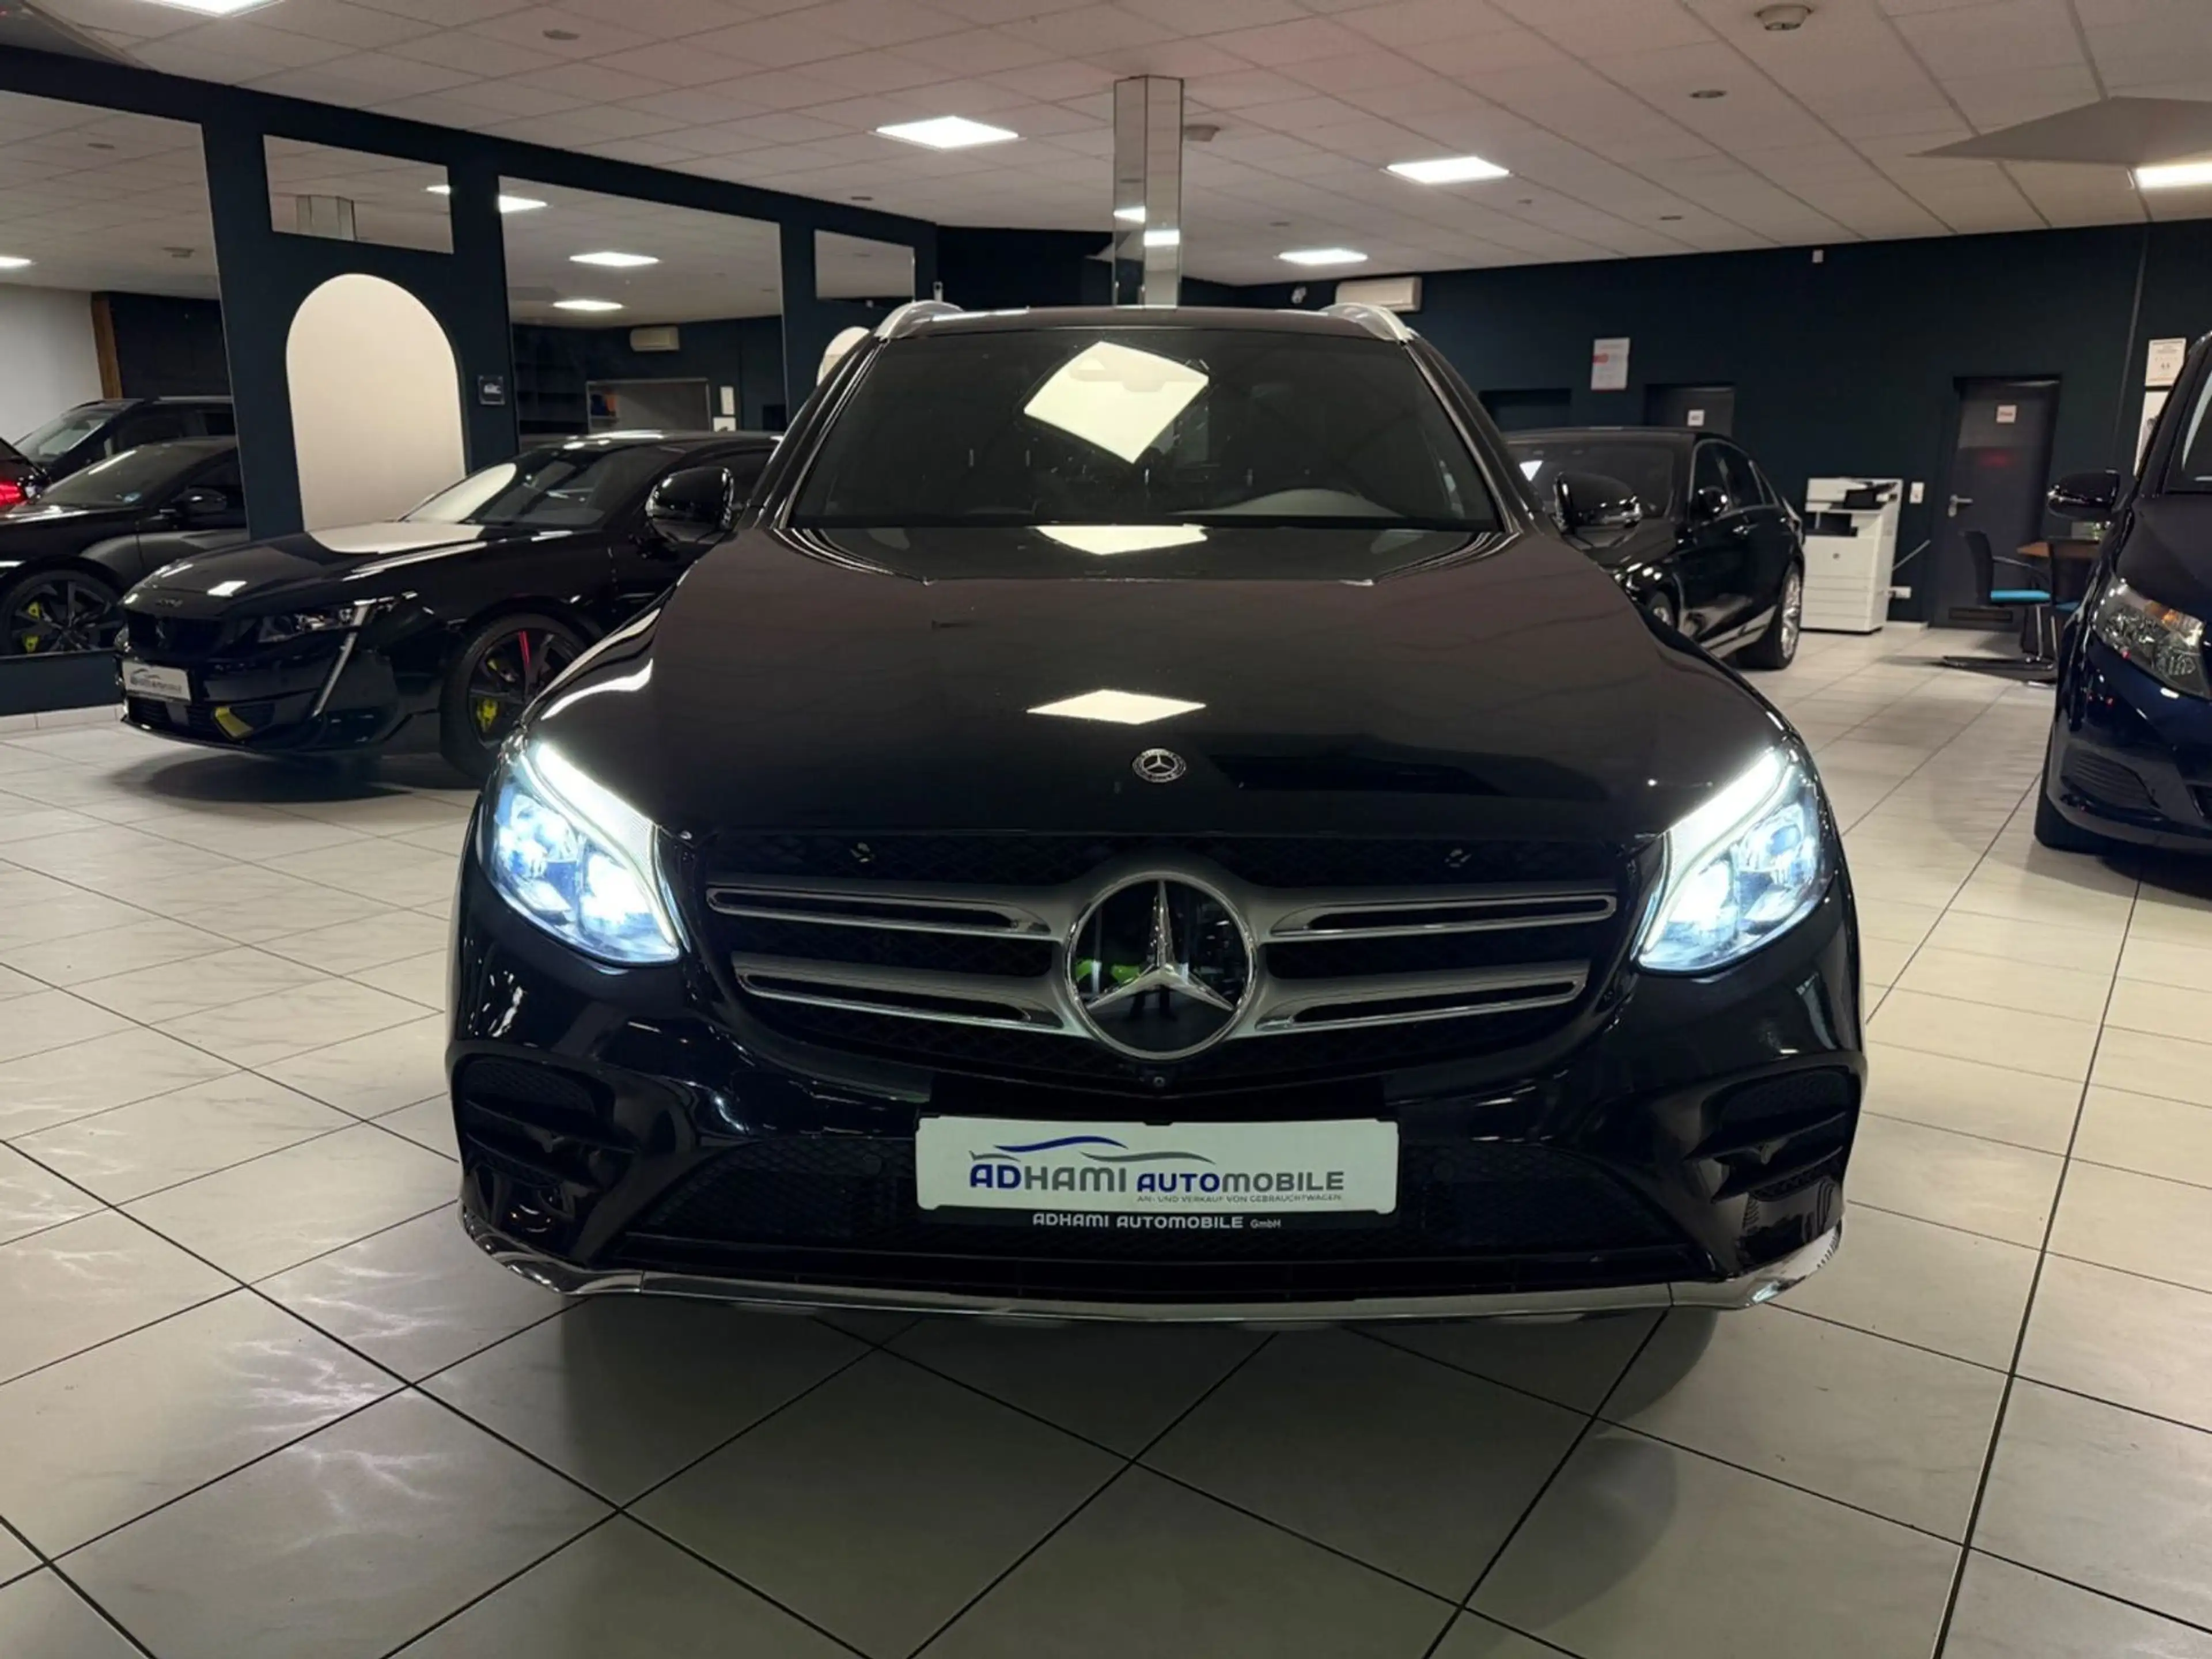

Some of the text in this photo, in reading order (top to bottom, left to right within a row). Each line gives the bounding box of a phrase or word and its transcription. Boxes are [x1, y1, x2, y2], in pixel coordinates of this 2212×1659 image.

[970, 1164, 1344, 1192] ADHAMI AUTOMOBILE
[1226, 1195, 1248, 1203] VON
[1032, 1213, 1282, 1229] ADHAMI AUTOMOBILE GmbH
